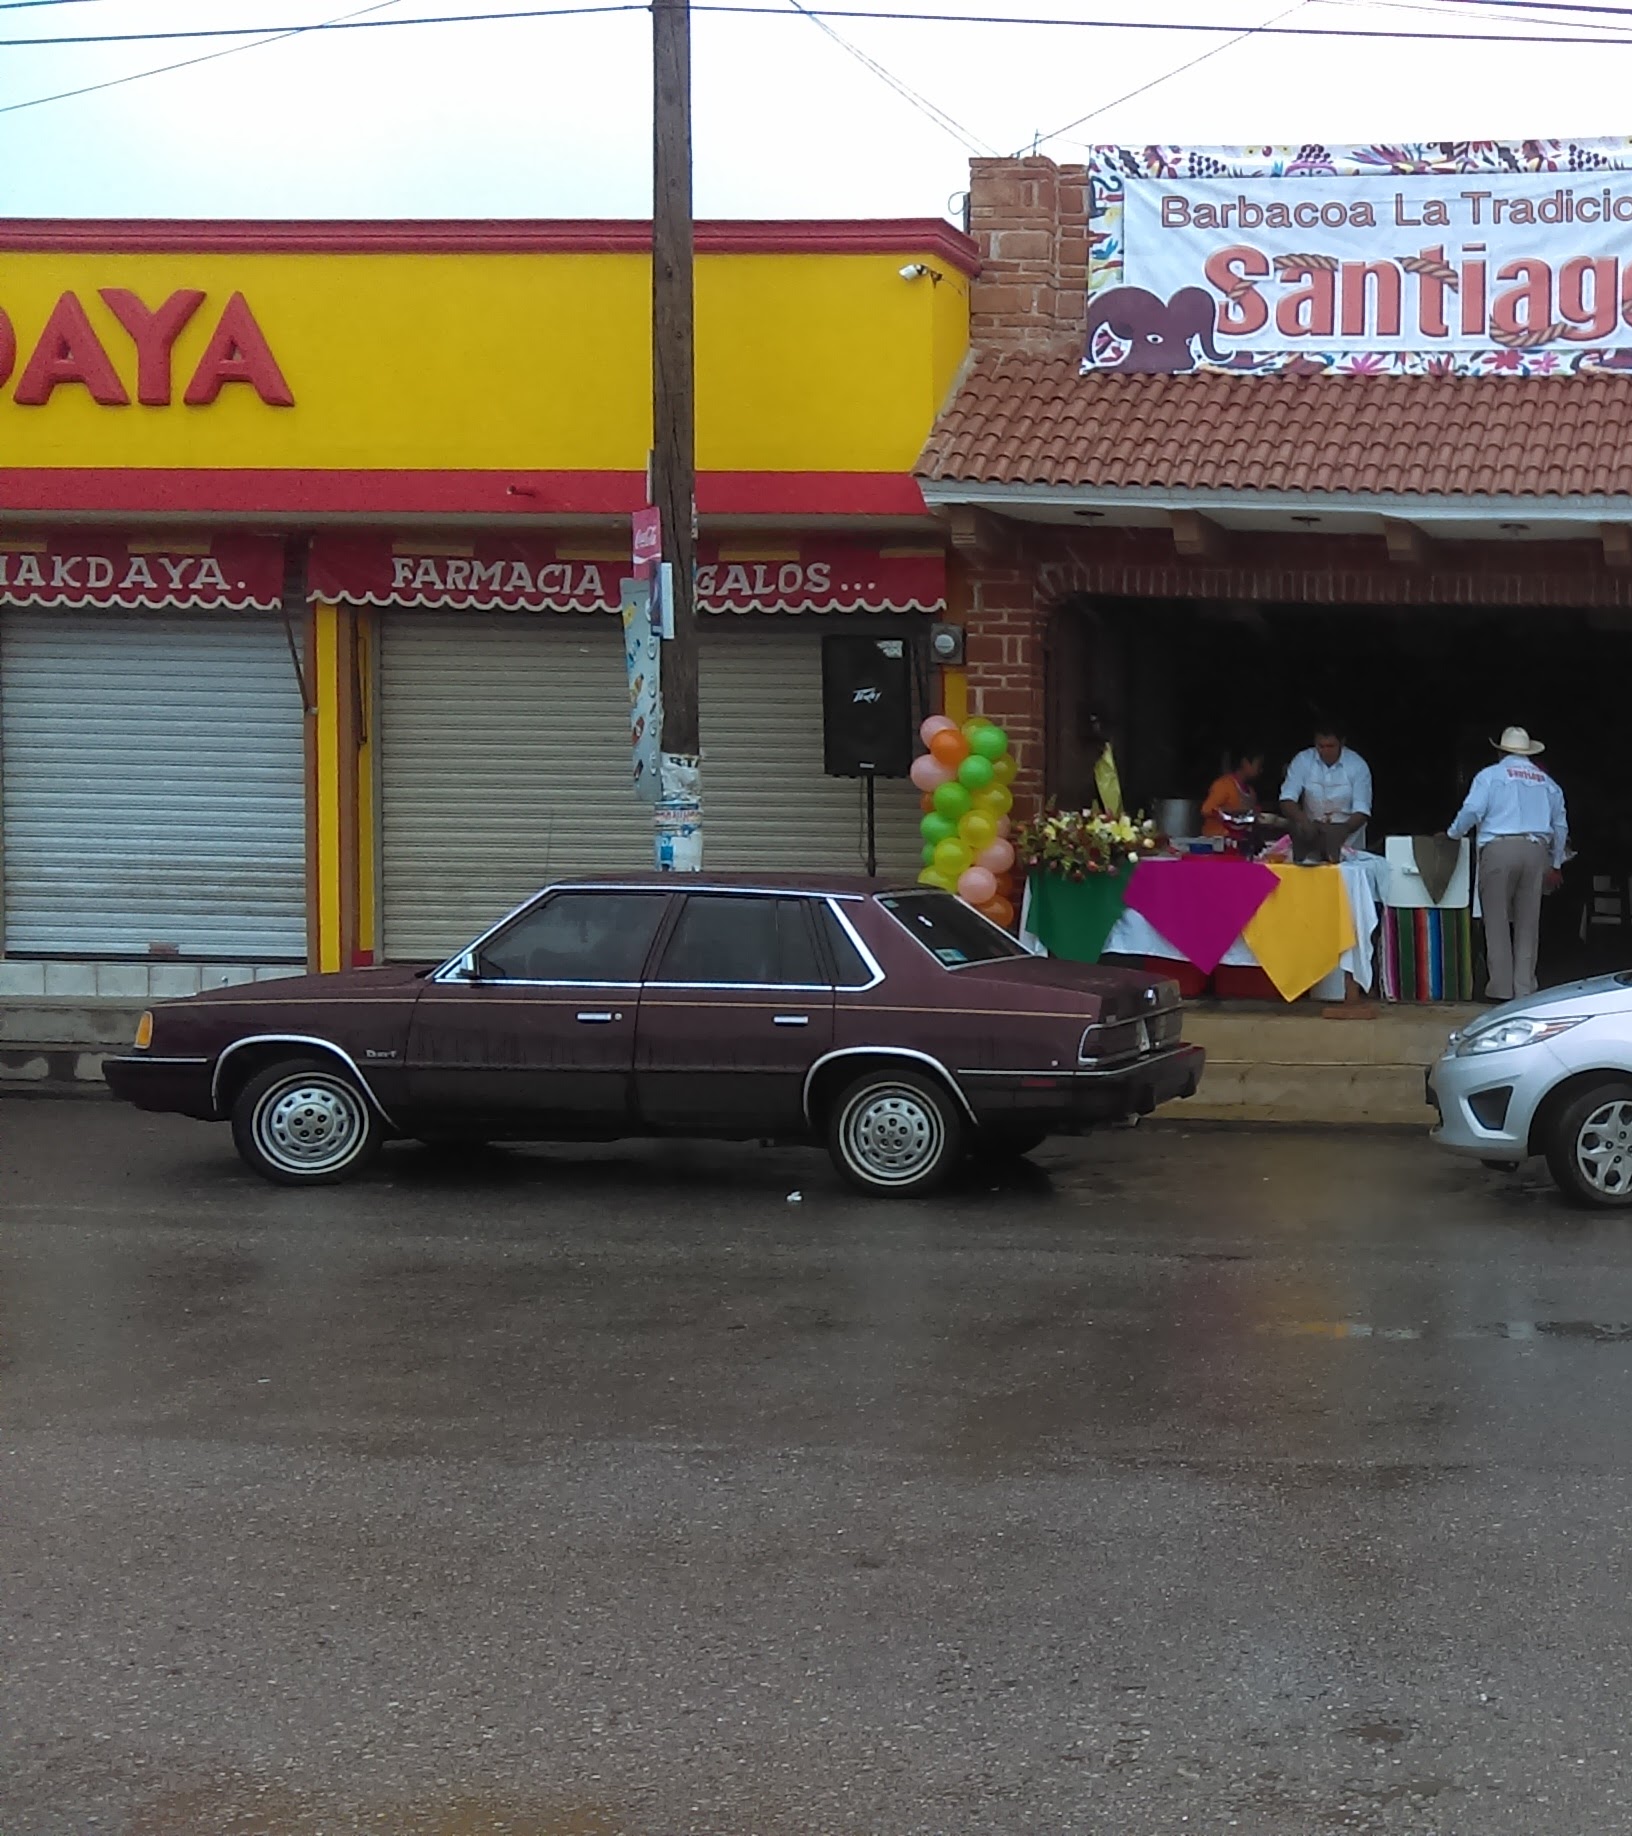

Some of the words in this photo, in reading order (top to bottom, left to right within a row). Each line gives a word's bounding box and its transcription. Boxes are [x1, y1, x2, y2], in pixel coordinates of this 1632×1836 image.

[1161, 194, 1377, 229] Barbacoa
[1394, 192, 1450, 227] La
[0, 287, 296, 406] AYA
[391, 557, 605, 596] FARMACIA
